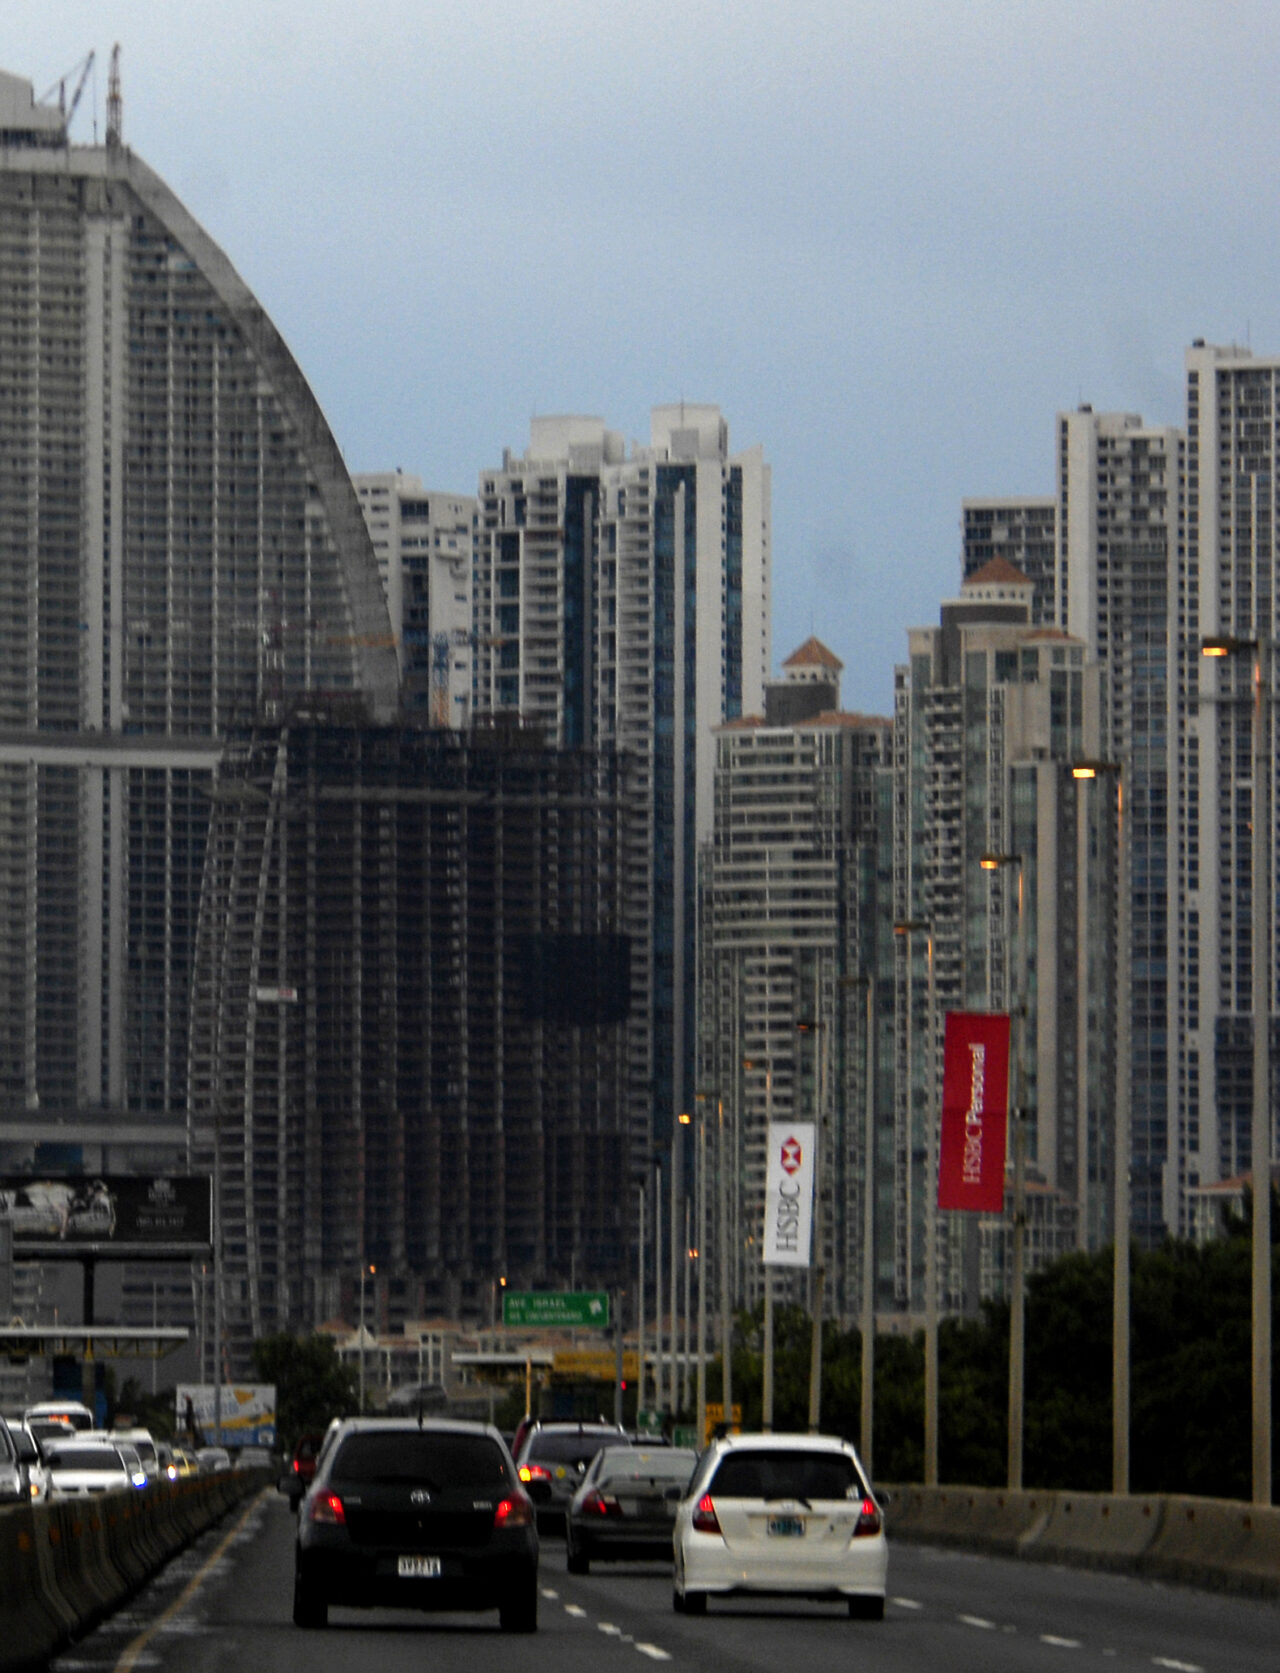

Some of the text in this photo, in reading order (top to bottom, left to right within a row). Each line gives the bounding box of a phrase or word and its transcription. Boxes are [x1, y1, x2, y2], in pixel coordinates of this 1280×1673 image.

[962, 1042, 986, 1184] HSBC Personal
[775, 1180, 801, 1254] HSBC
